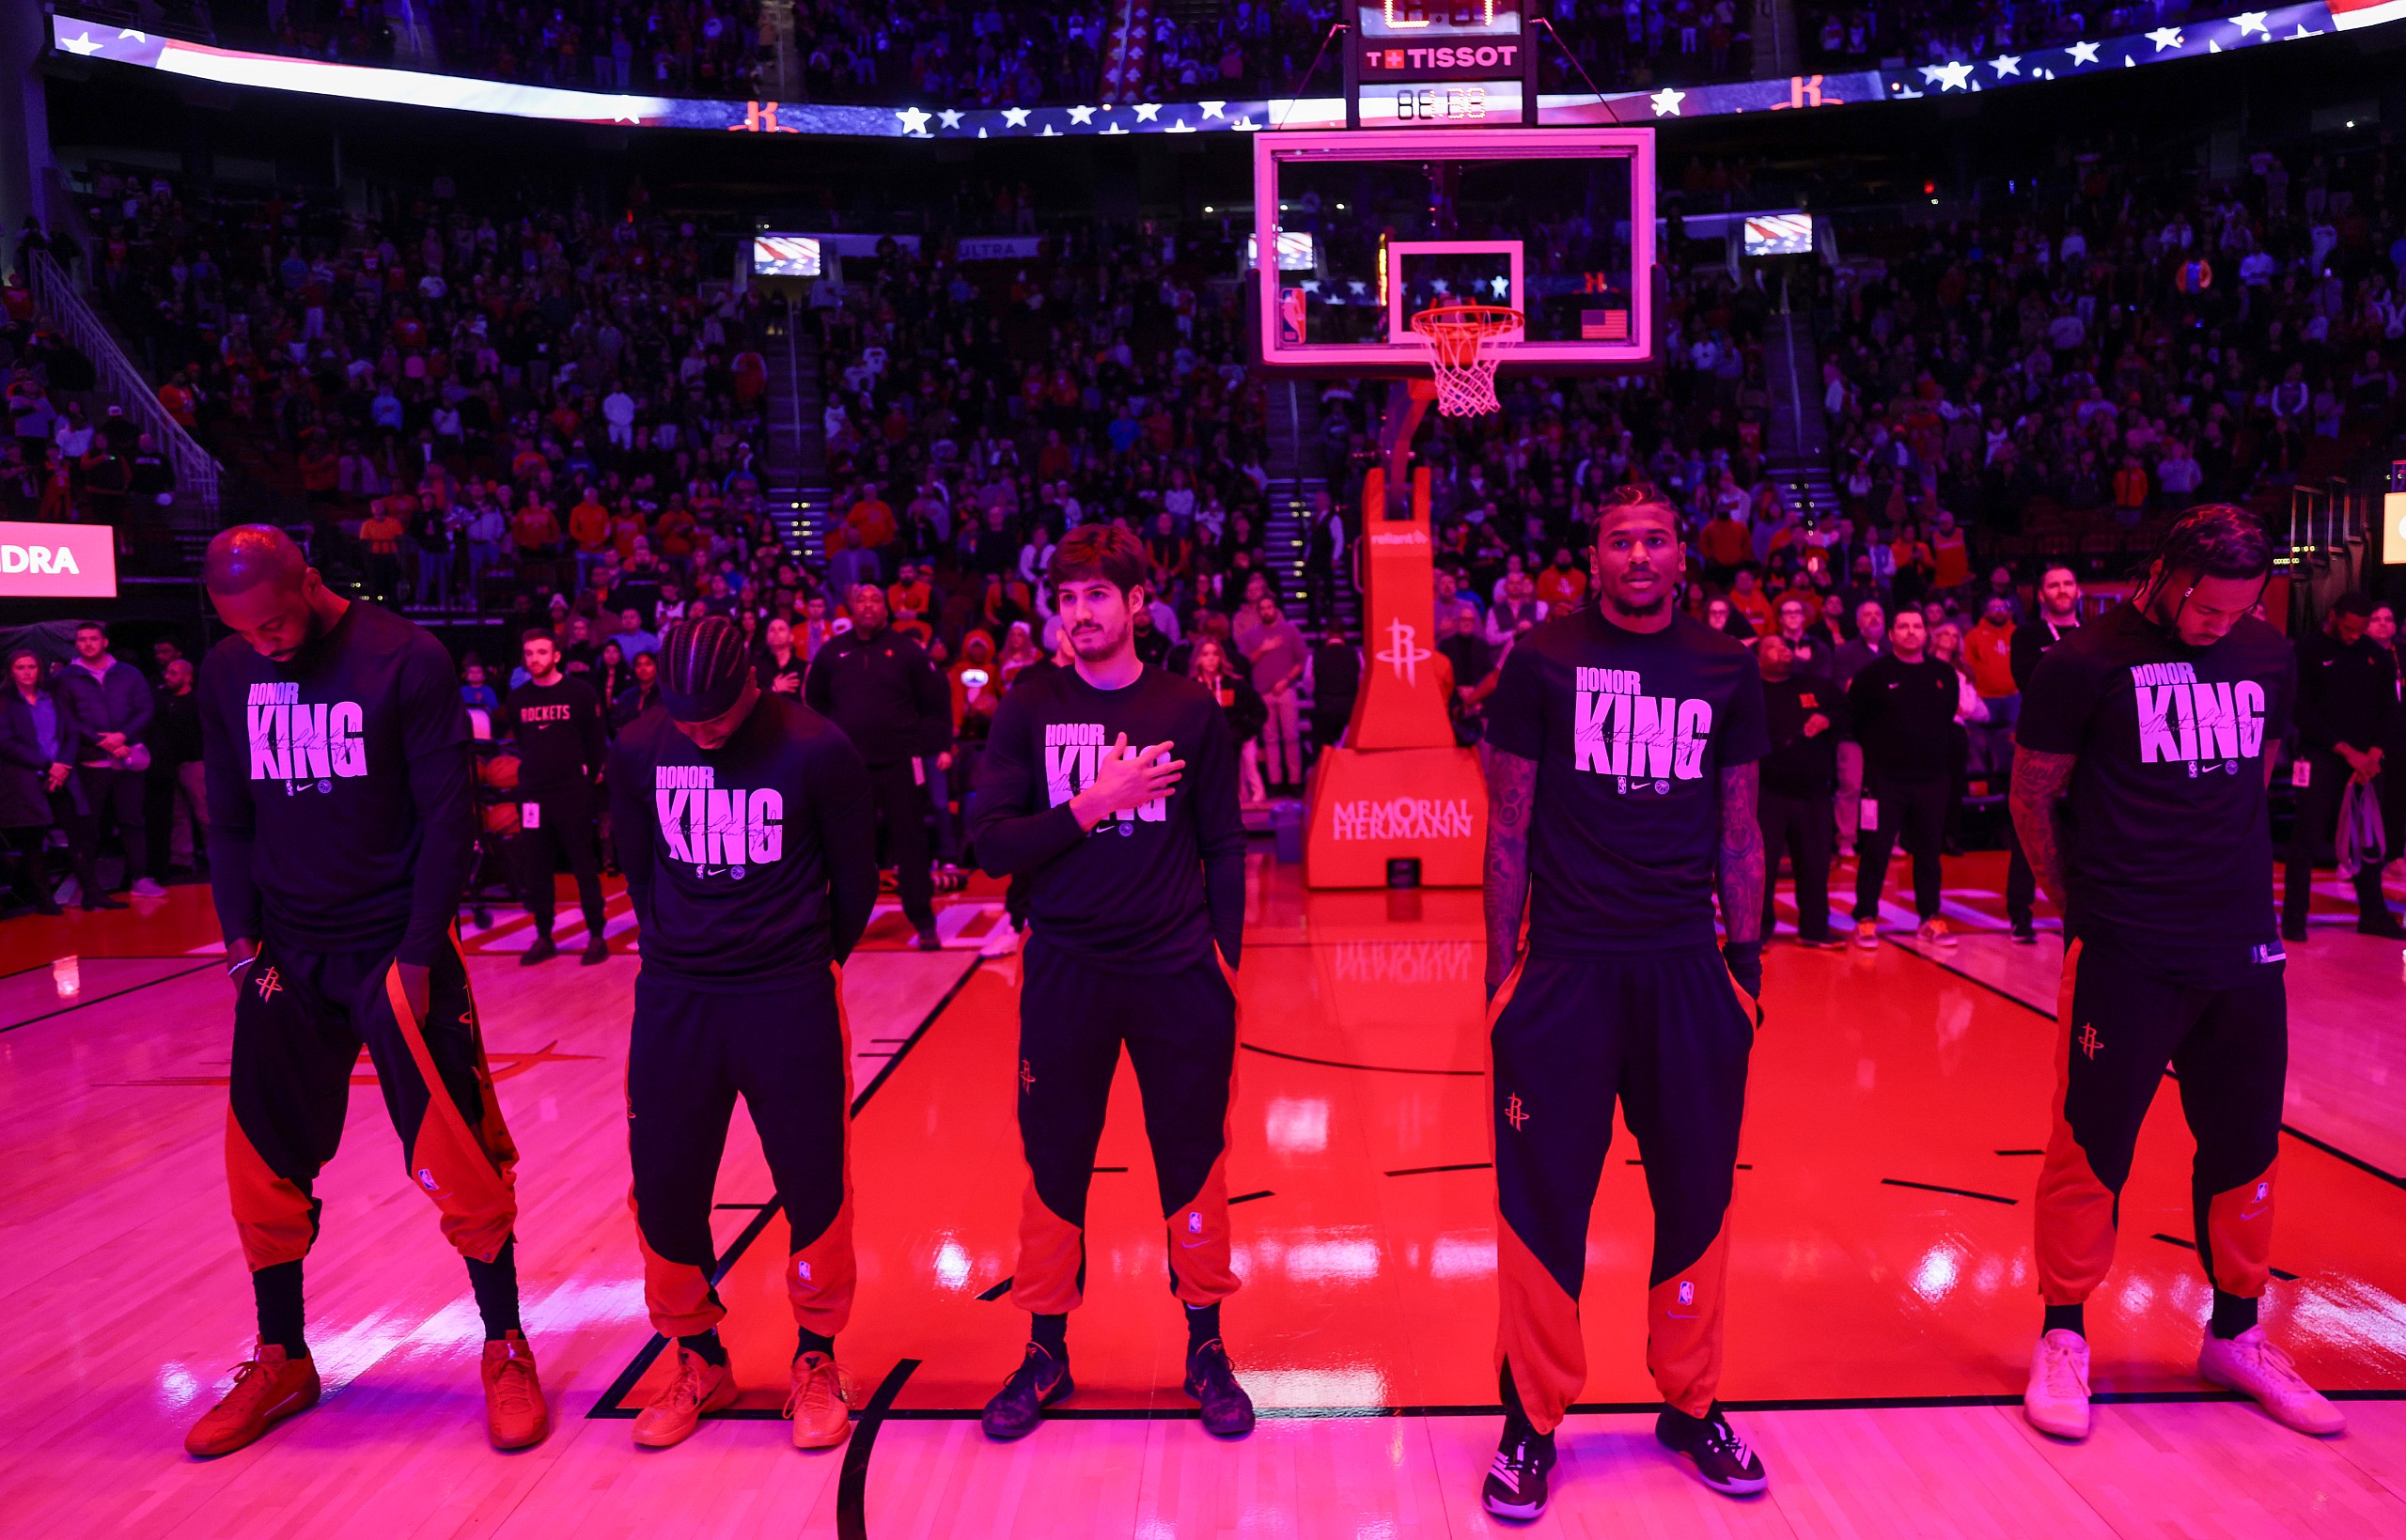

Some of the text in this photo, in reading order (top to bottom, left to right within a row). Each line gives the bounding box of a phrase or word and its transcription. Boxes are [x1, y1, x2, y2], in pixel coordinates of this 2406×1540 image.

[1407, 46, 1517, 69] TISSOT
[0, 545, 81, 574] DRA
[1576, 666, 1641, 695] HONOR
[2130, 662, 2197, 687] HONOR
[247, 682, 299, 705] HONOR
[521, 705, 570, 723] ROCKETS
[2134, 680, 2265, 763] KING
[247, 701, 367, 779] KING
[1045, 723, 1105, 745] HONOR
[1574, 691, 1712, 780] KING
[656, 766, 714, 788] HONOR
[1334, 797, 1474, 823] MEMORIAL
[656, 788, 784, 865] KING
[1333, 816, 1472, 840] HERMANN
